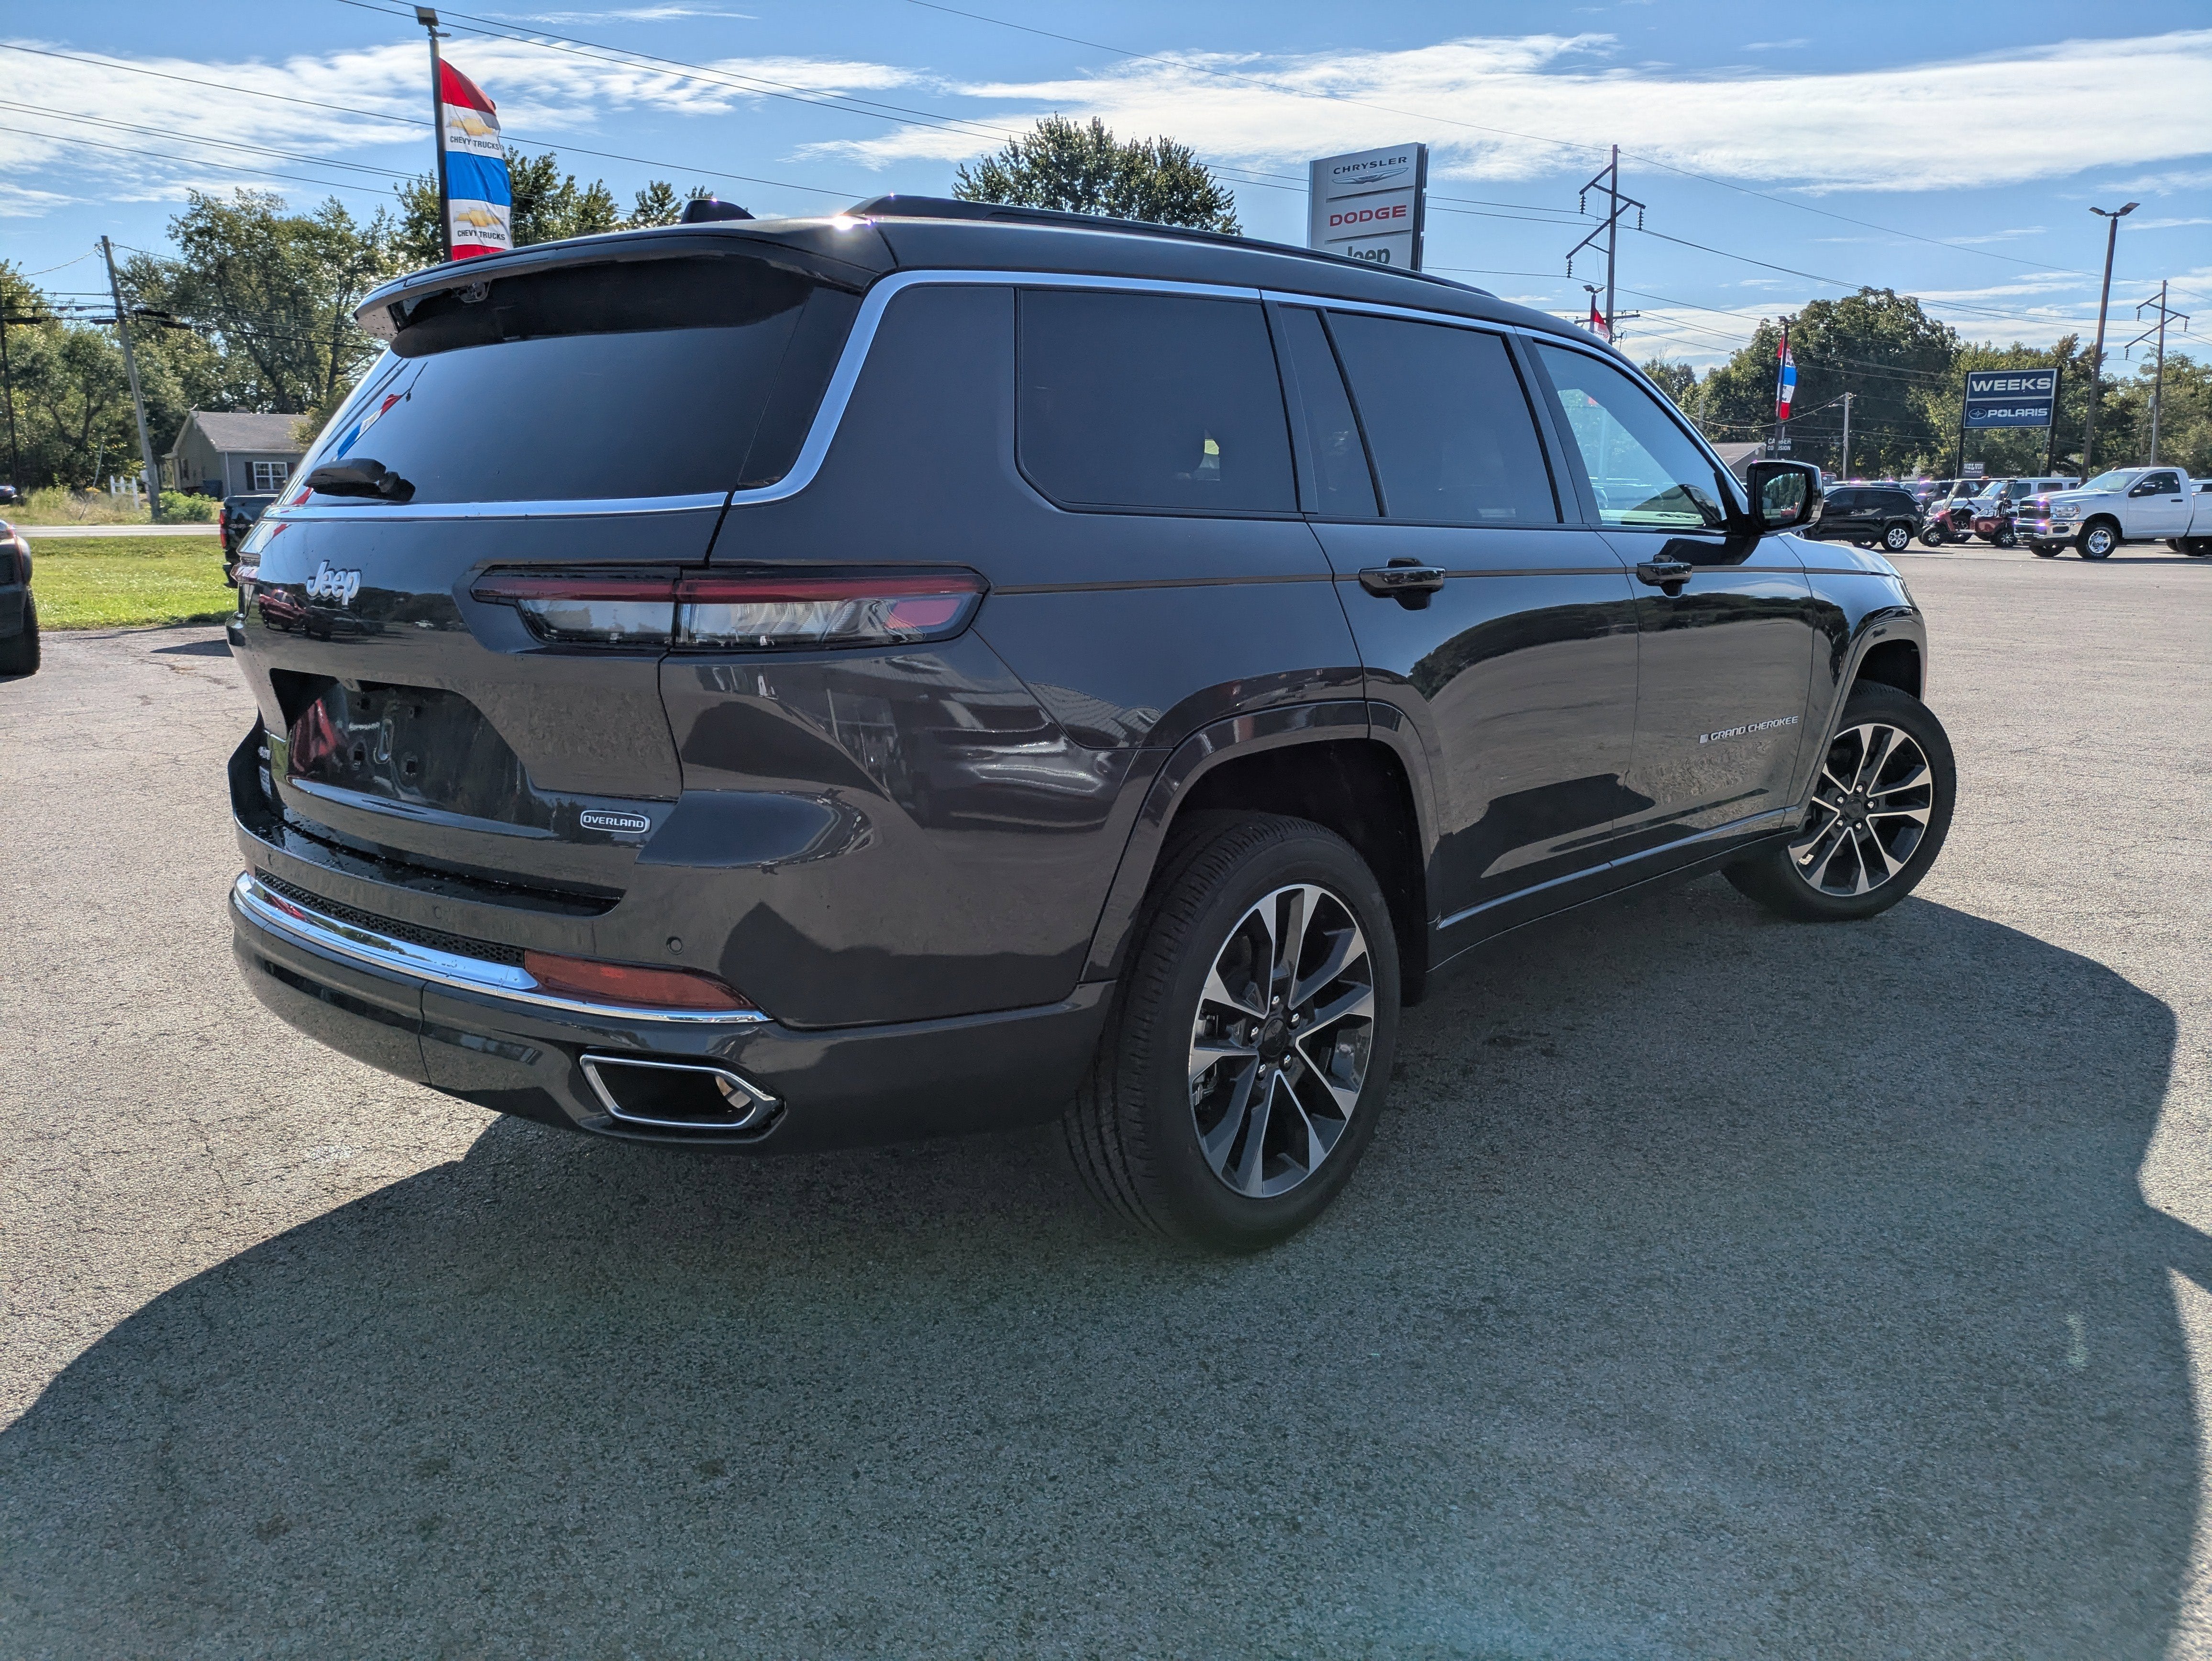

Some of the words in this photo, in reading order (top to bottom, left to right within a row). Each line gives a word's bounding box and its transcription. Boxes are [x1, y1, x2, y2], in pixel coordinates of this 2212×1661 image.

[450, 136, 471, 145] CHEVY
[473, 140, 499, 150] TRUCKS
[1333, 156, 1407, 175] CHRYSLER
[1329, 205, 1407, 227] DODGE
[479, 231, 506, 240] TRUCKS
[1972, 378, 2051, 392] WEEKS
[1987, 408, 2048, 417] POLARIS
[306, 560, 361, 606] Jeep
[1710, 726, 1746, 741] GRAND
[1747, 716, 1798, 732] CHEROKEE
[583, 815, 644, 828] OVERLAND
